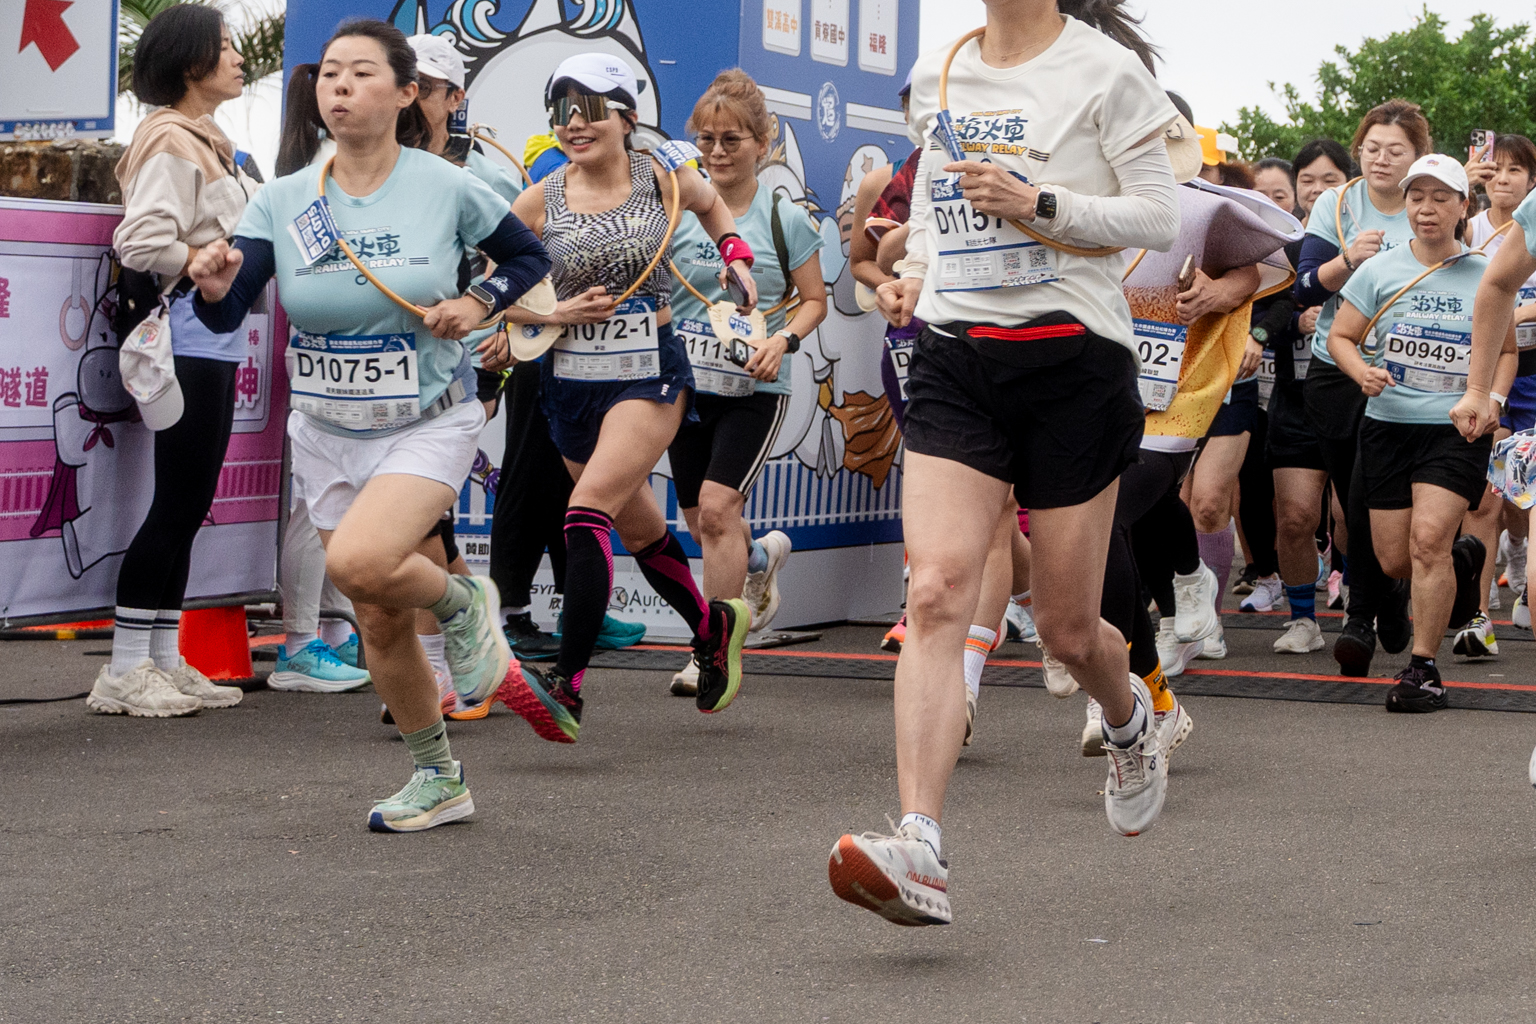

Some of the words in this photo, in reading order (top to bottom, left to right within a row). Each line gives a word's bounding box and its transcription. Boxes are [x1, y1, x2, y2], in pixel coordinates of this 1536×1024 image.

[868, 32, 887, 56] 福隆
[661, 141, 686, 166] D1072
[991, 142, 1028, 156] RELAY
[370, 256, 406, 270] RELAY
[692, 259, 723, 269] RAILWAY
[1406, 312, 1440, 321] RAILWAY
[1441, 313, 1466, 322] RELAY
[1138, 340, 1183, 366] 02-
[296, 352, 411, 384] D1075-1
